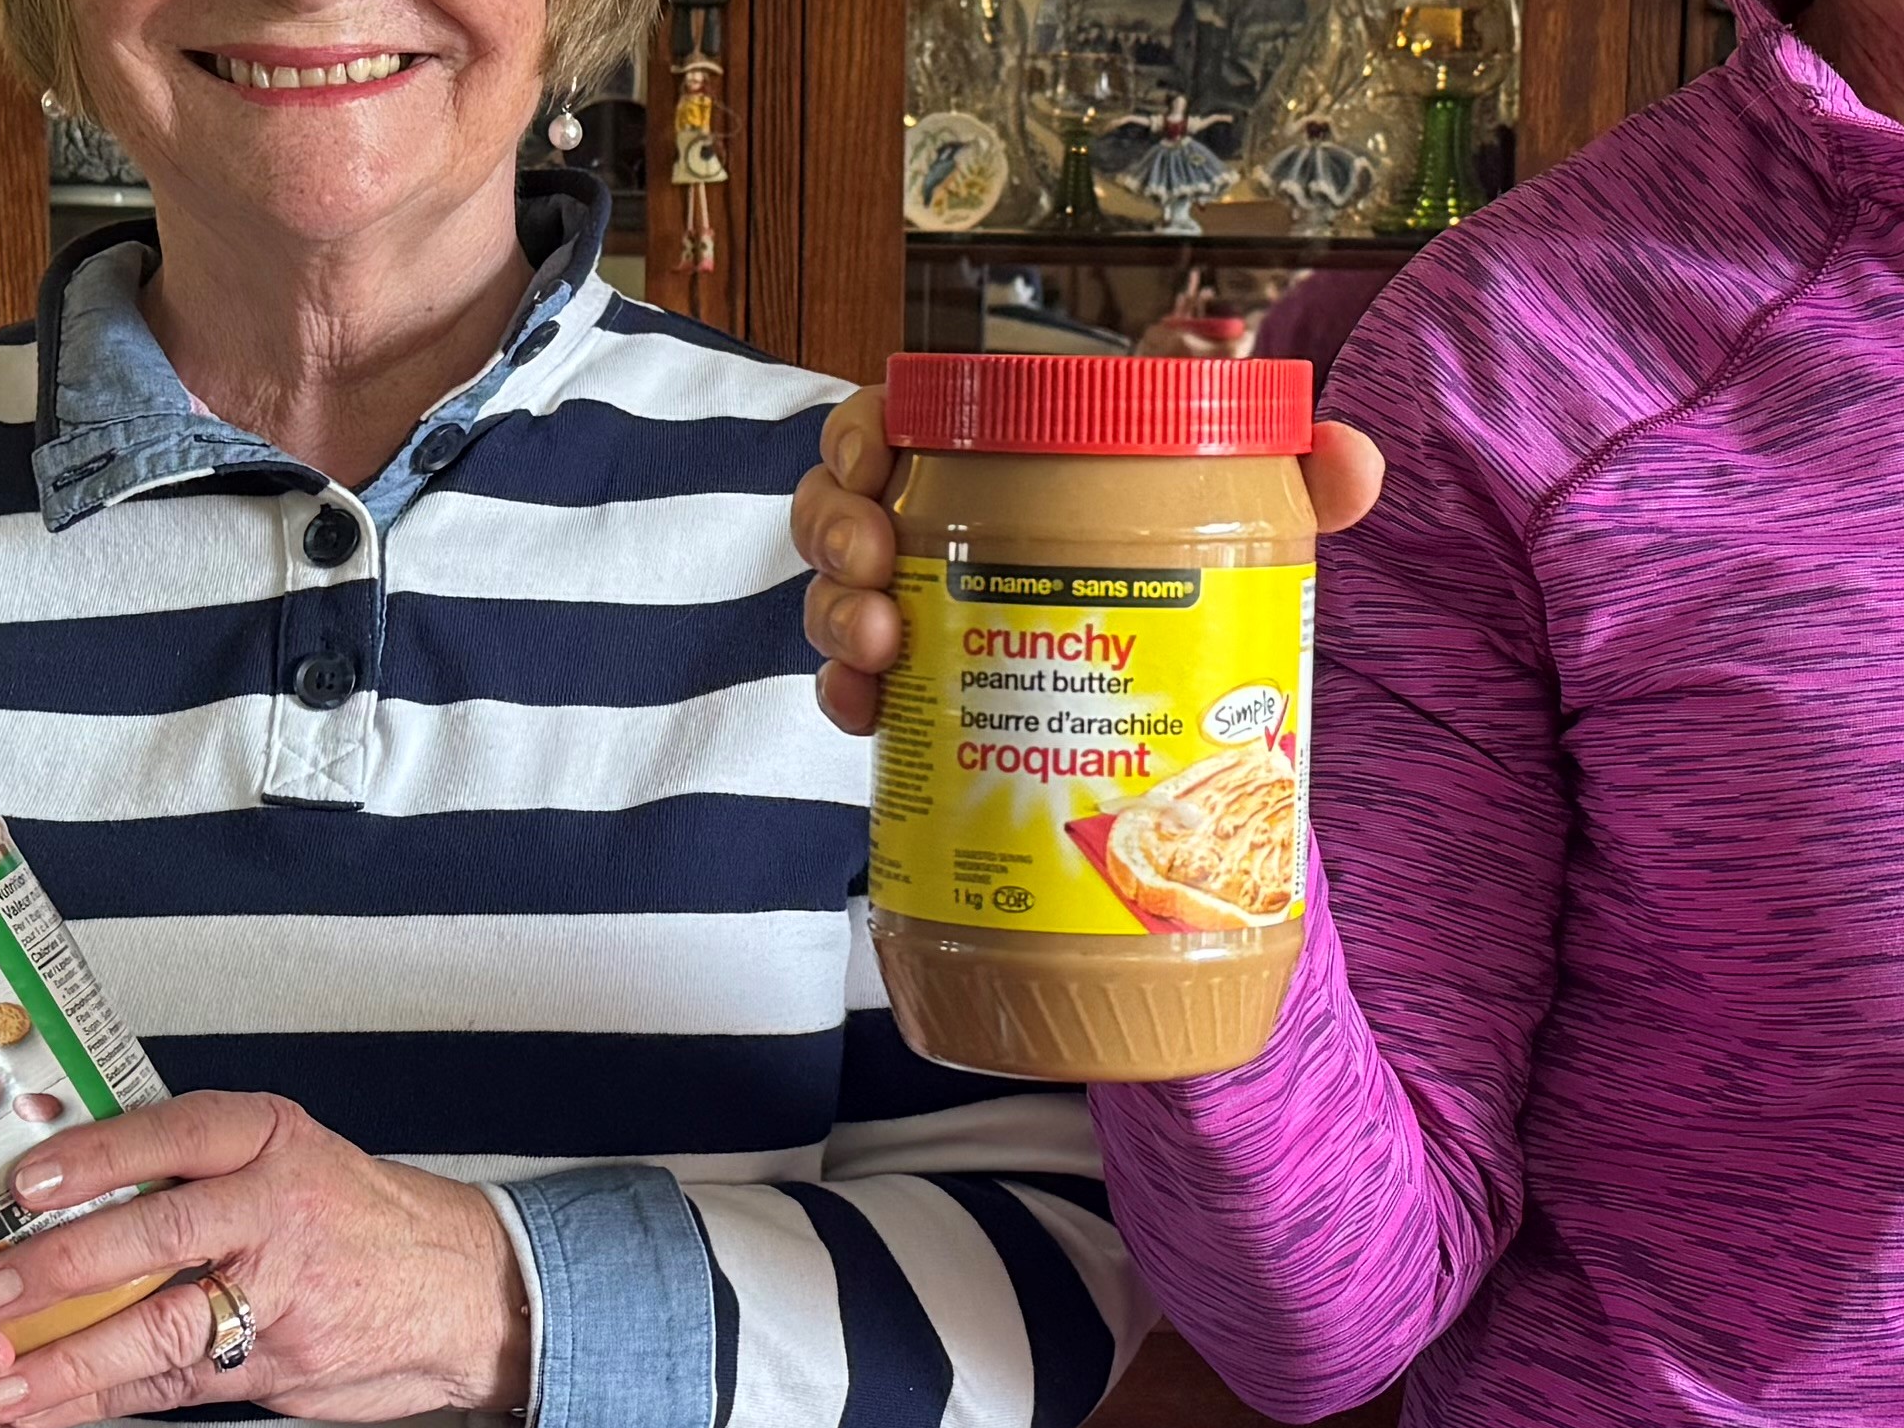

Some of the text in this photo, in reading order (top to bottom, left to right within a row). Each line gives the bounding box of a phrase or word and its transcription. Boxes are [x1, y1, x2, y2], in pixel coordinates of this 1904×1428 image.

[960, 575, 985, 592] no
[1071, 579, 1129, 598] sans
[962, 623, 1137, 671] crunchy
[960, 670, 1134, 694] peanut butter
[960, 706, 1184, 736] beurre d'arachide
[1215, 690, 1276, 736] Simple
[956, 741, 1152, 784] croquant
[953, 887, 984, 911] 1 kg
